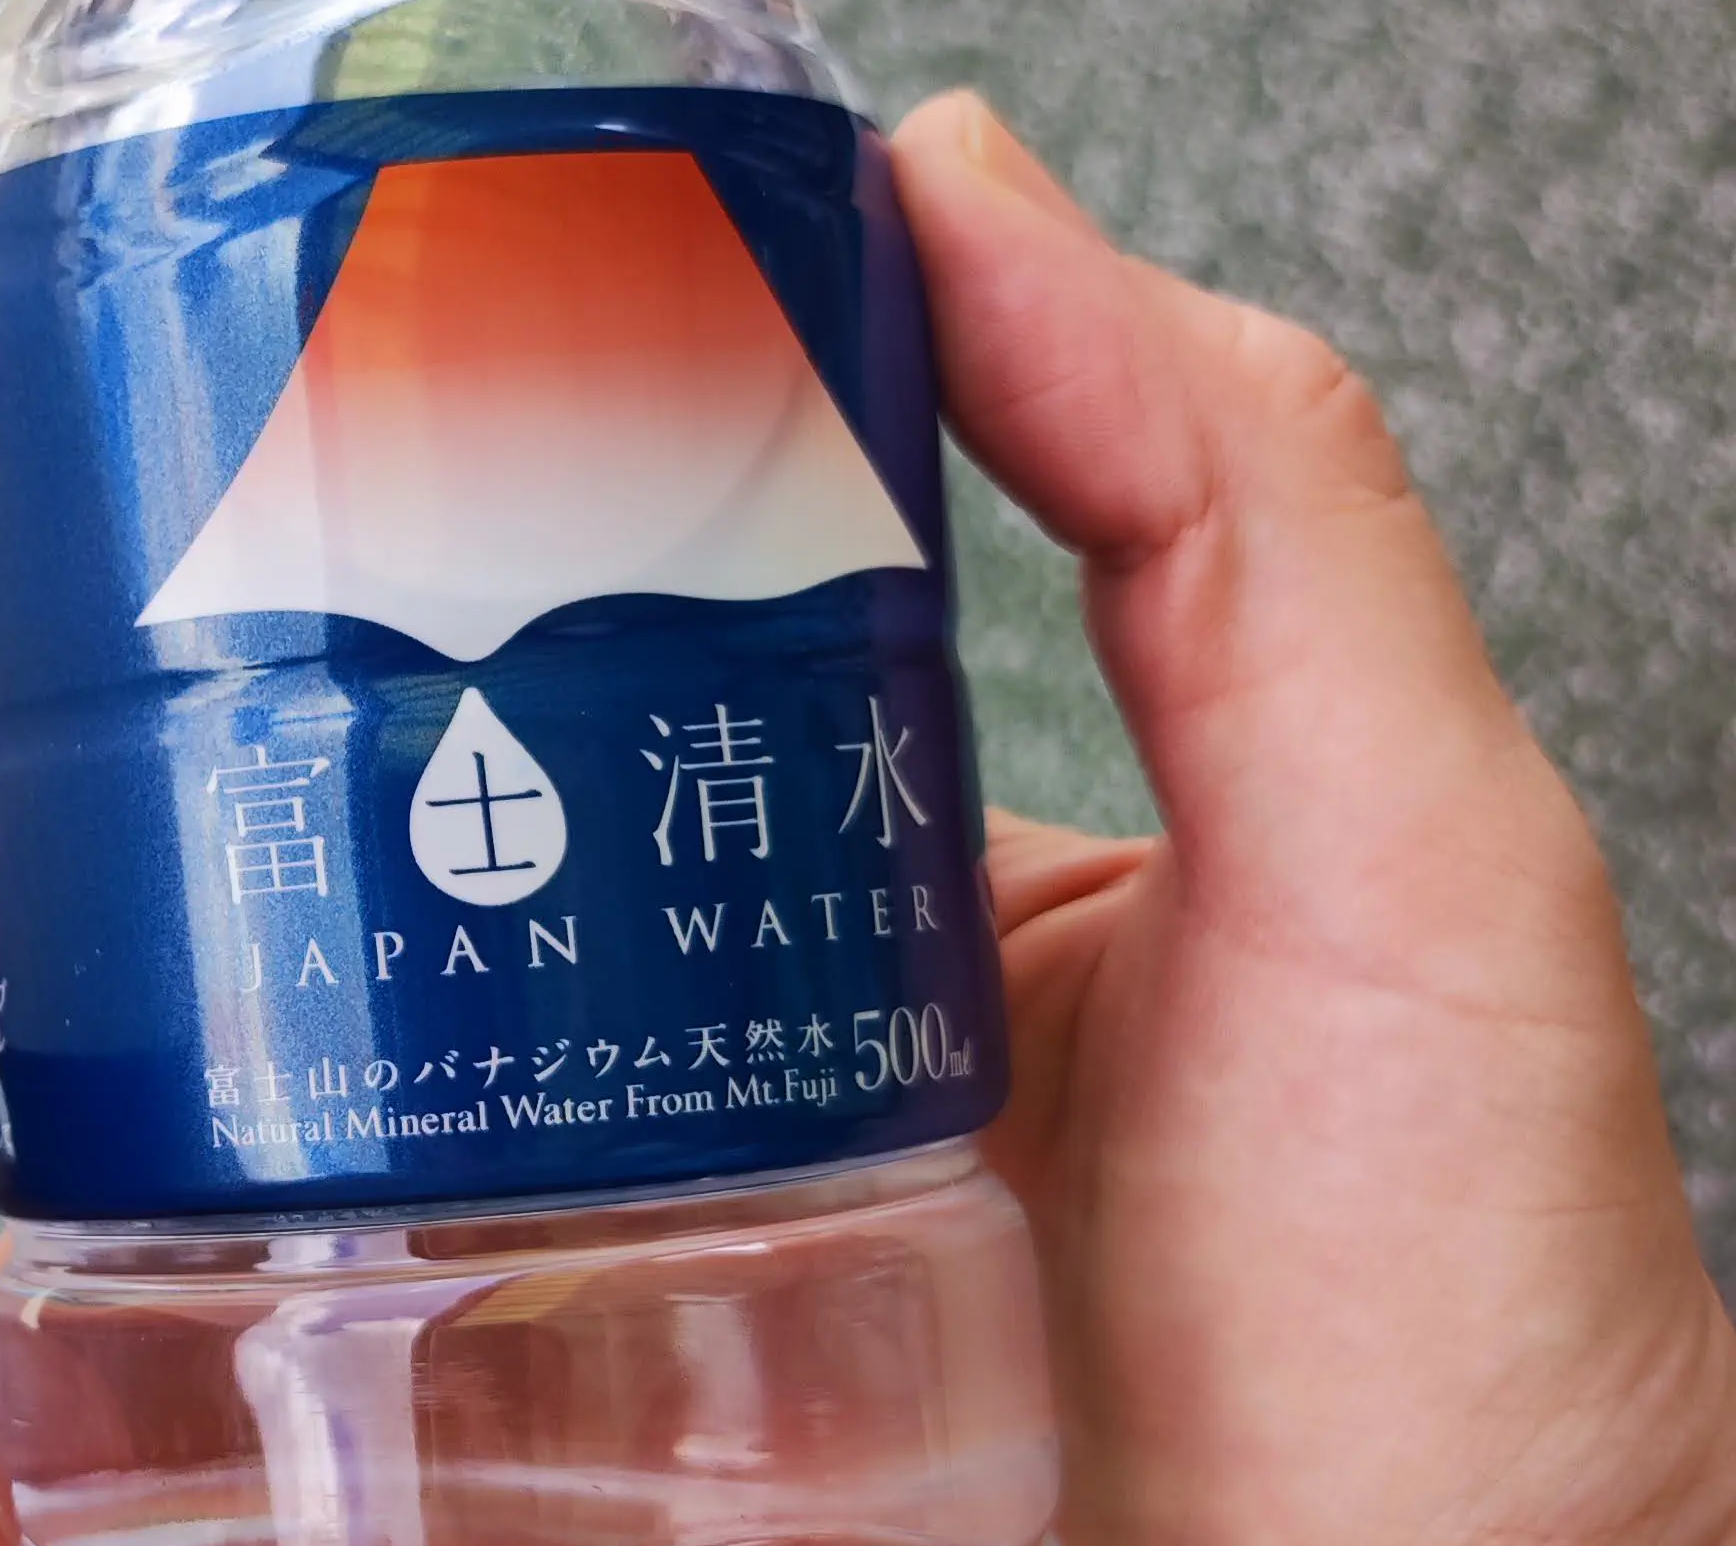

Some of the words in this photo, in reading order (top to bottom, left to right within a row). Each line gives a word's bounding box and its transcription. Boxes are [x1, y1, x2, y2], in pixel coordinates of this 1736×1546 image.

[239, 915, 580, 994] JAPAN
[662, 883, 938, 955] WATER
[206, 1012, 835, 1108] 富士山のバナジウム天然水
[211, 1108, 334, 1150] Natural
[345, 1102, 488, 1140] Mineral
[502, 1093, 610, 1128] Water
[625, 1083, 713, 1118] From
